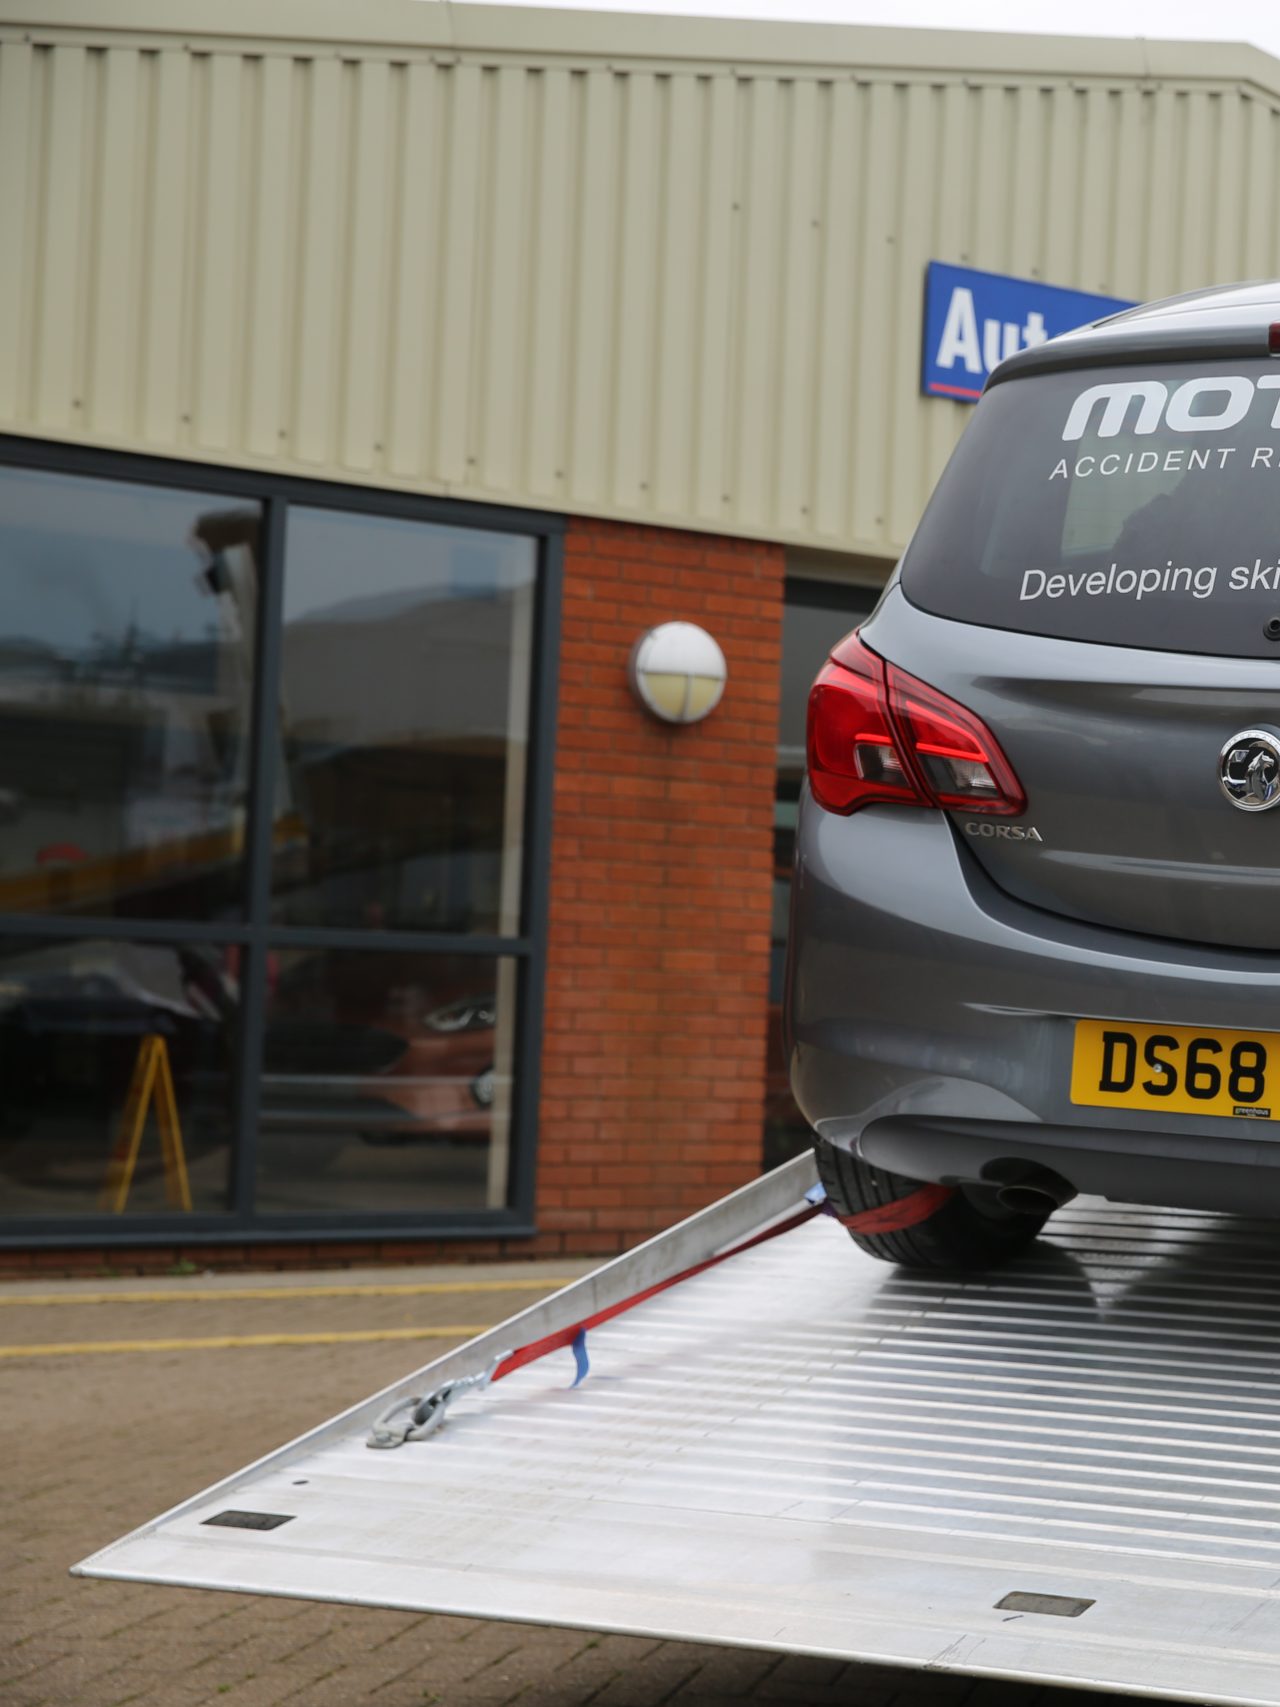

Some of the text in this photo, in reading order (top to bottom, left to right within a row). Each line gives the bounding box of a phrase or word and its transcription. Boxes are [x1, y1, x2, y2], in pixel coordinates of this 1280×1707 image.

[1049, 448, 1236, 480] ACCIDENT
[1020, 560, 1217, 600] Developing
[965, 822, 1043, 842] CORSA
[1099, 1031, 1267, 1103] DS68
